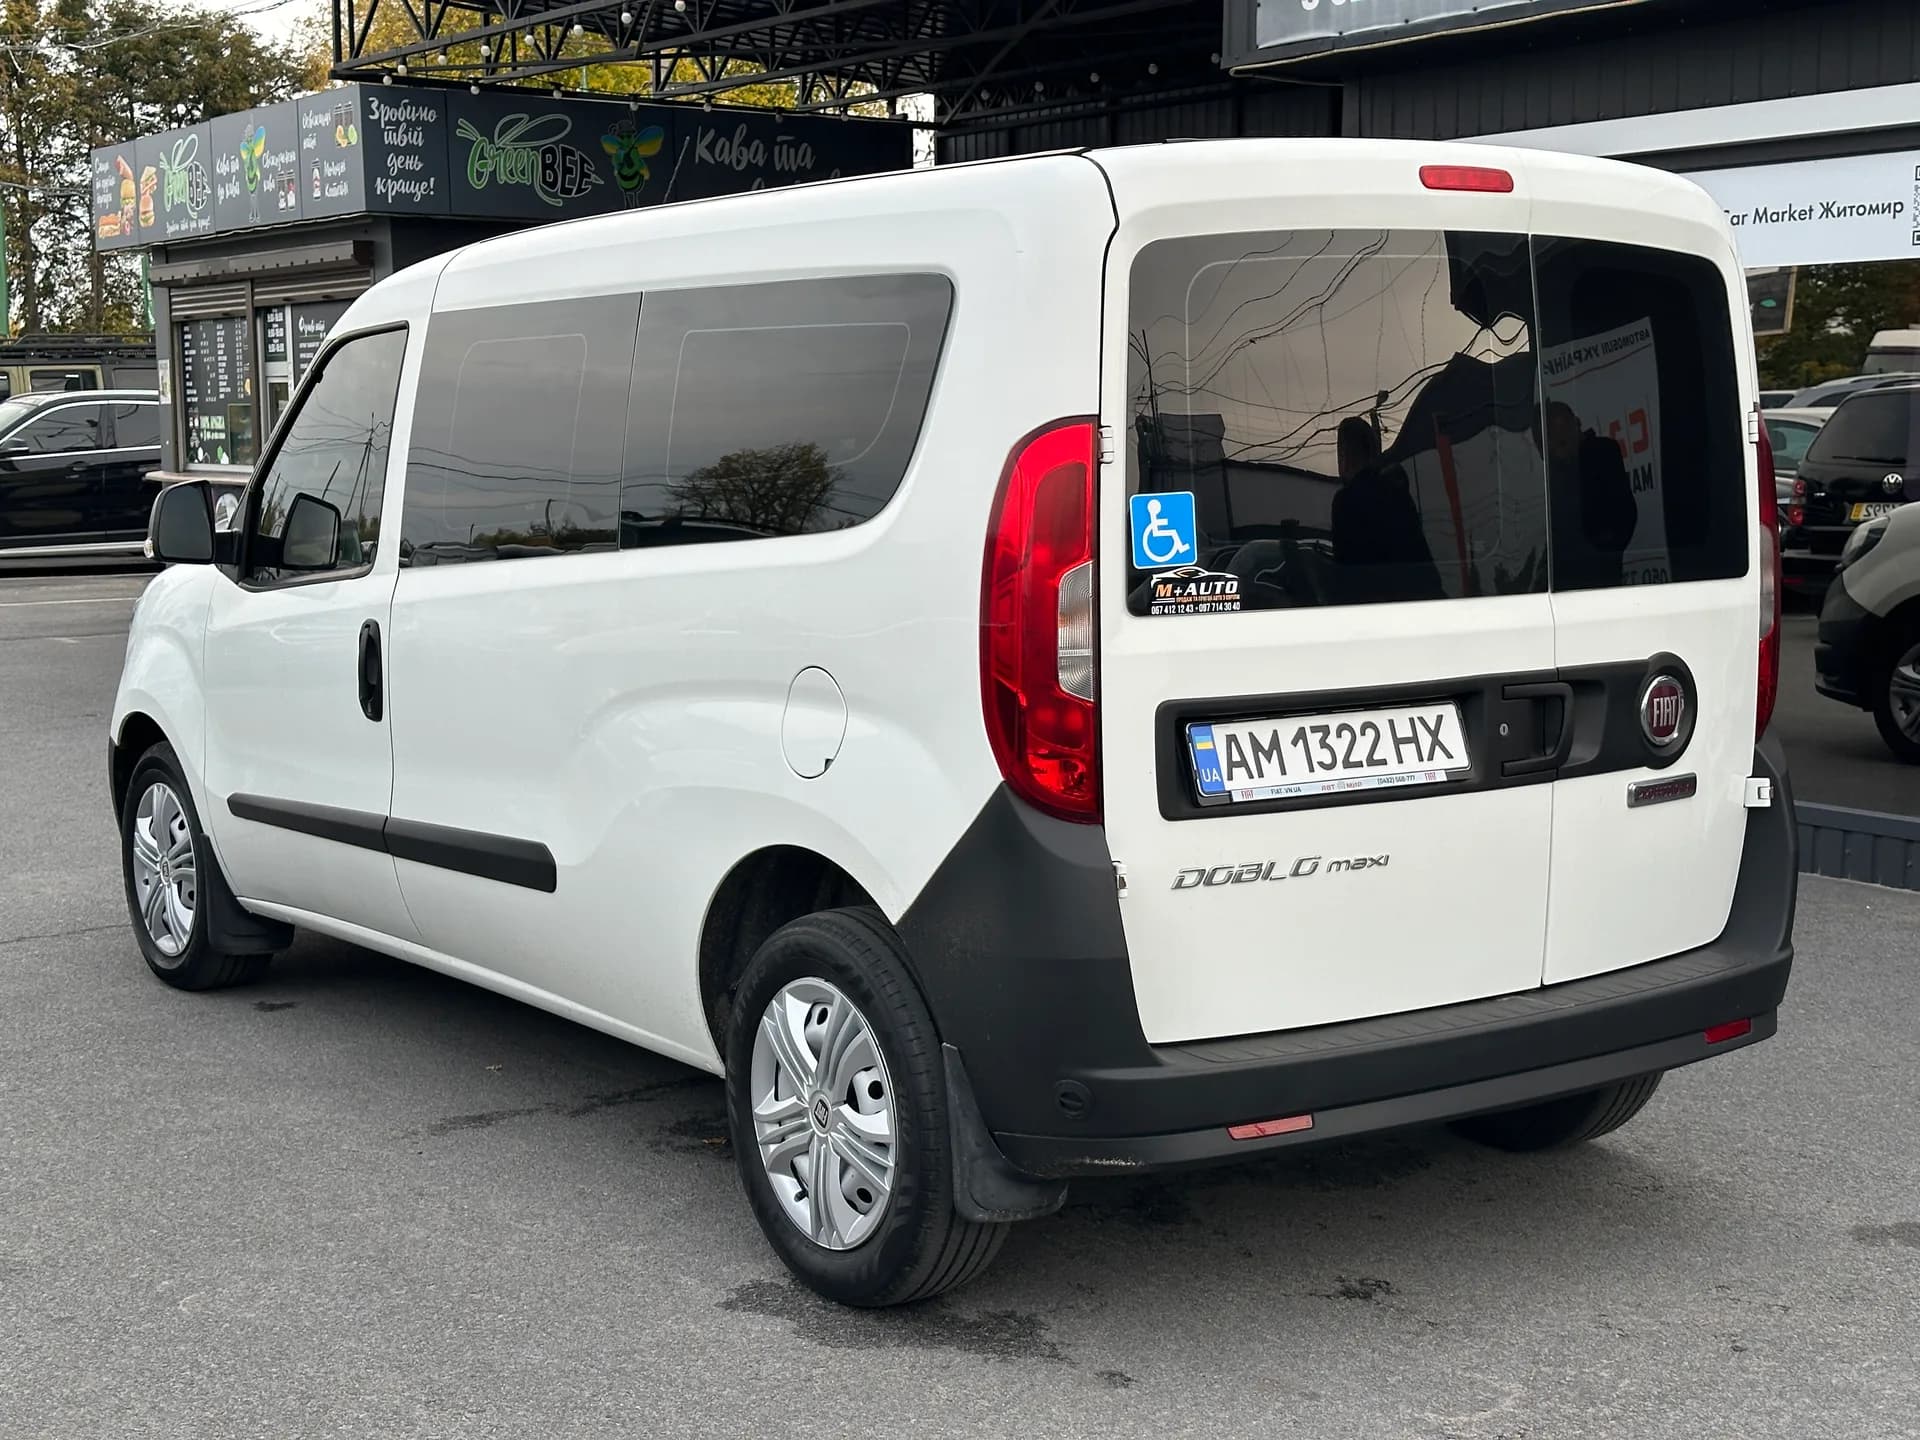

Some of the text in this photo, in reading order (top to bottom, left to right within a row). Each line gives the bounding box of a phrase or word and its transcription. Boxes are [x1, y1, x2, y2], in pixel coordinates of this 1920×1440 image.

[369, 97, 437, 128] Зробимо
[384, 122, 424, 147] твій
[695, 123, 816, 172] Кава та
[387, 152, 424, 177] день
[375, 177, 435, 204] краще!
[1753, 203, 1814, 225] Market
[1818, 200, 1904, 220] Житомир
[1653, 696, 1677, 728] FIAT
[1225, 714, 1454, 782] AM 1322 HX
[1201, 768, 1221, 783] UA
[1170, 854, 1390, 890] DOBLO maxi
